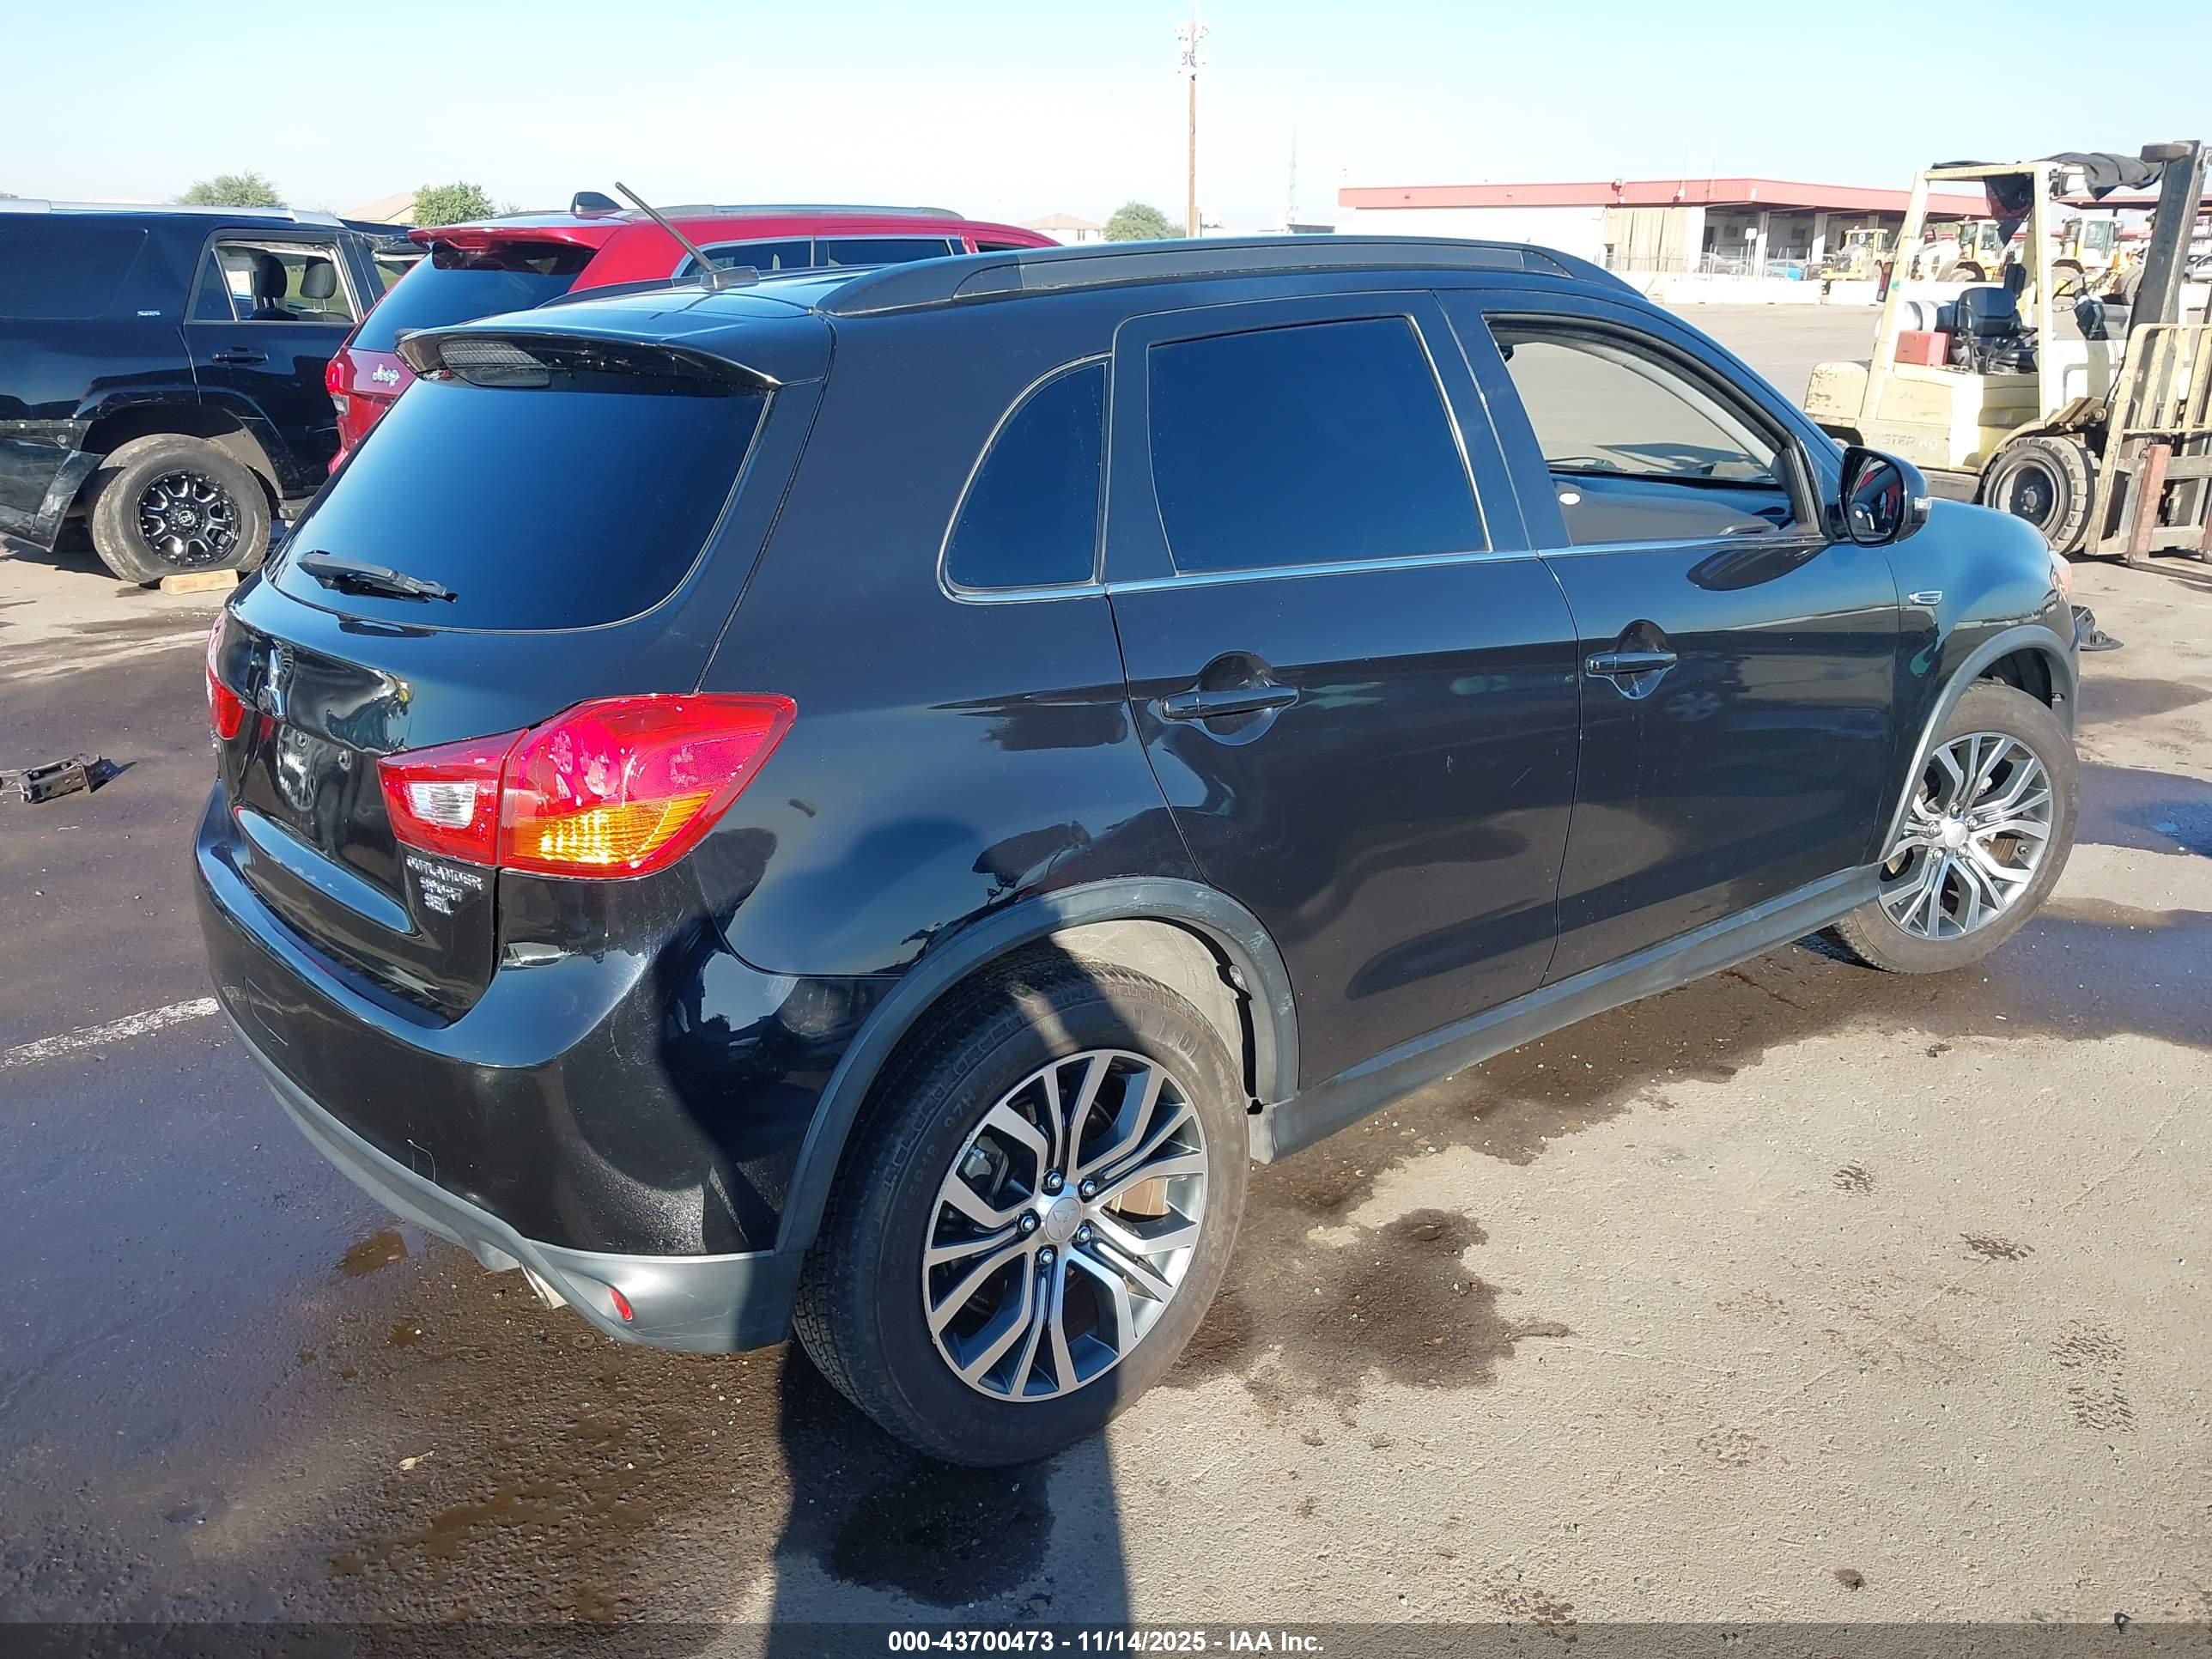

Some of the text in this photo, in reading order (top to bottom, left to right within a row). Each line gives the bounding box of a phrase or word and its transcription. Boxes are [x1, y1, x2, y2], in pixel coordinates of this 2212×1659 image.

[1858, 233, 1866, 244] 9
[372, 363, 400, 387] Jeep
[406, 854, 484, 890] OUTLANDER
